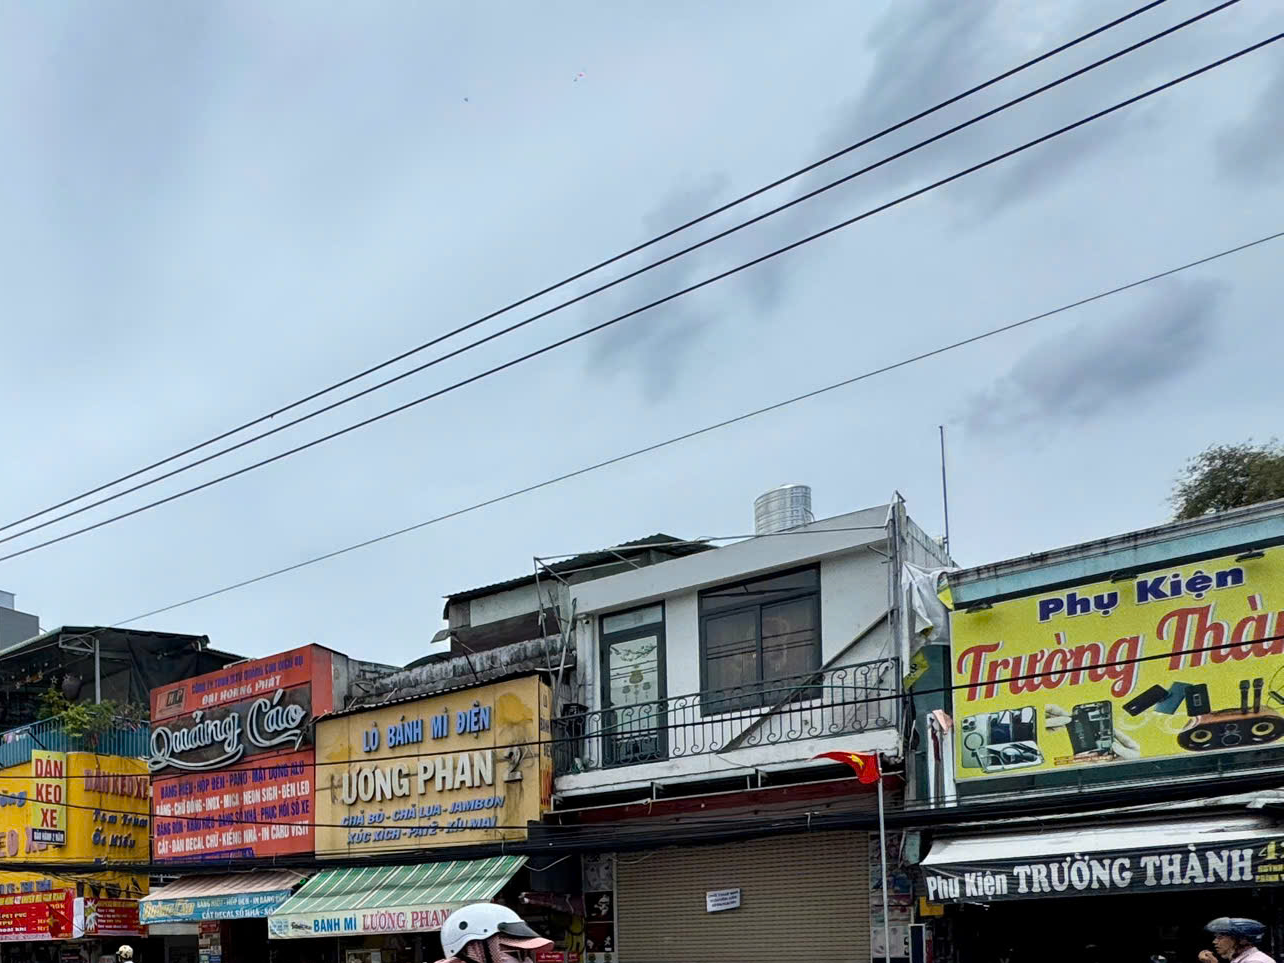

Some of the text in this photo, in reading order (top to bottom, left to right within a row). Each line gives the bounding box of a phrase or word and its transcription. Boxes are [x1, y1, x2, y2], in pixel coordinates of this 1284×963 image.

[1037, 564, 1244, 622] Phụ Kiện
[956, 632, 1142, 702] Trường
[148, 688, 306, 772] Quảng Cáo
[387, 715, 423, 749] BÁNH
[431, 707, 449, 739] MÌ
[35, 755, 63, 779] DÁN
[229, 771, 248, 786] PANO
[417, 750, 496, 796] PHAN
[35, 783, 62, 804] KEO
[243, 789, 261, 805] NEON
[297, 779, 310, 796] LED
[449, 796, 506, 814] JAMBON
[40, 808, 57, 828] XE
[301, 799, 309, 814] XE
[185, 836, 204, 851] DECAL
[261, 825, 269, 841] IN
[291, 820, 309, 837] VISIT
[926, 875, 960, 901] Phụ
[964, 870, 1008, 900] Kiện
[1013, 852, 1133, 894] TRƯỜNG
[1140, 843, 1254, 887] THÀNH
[313, 916, 341, 933] BÁNH
[344, 913, 357, 931] MÌ
[362, 910, 406, 931] LƯƠNG
